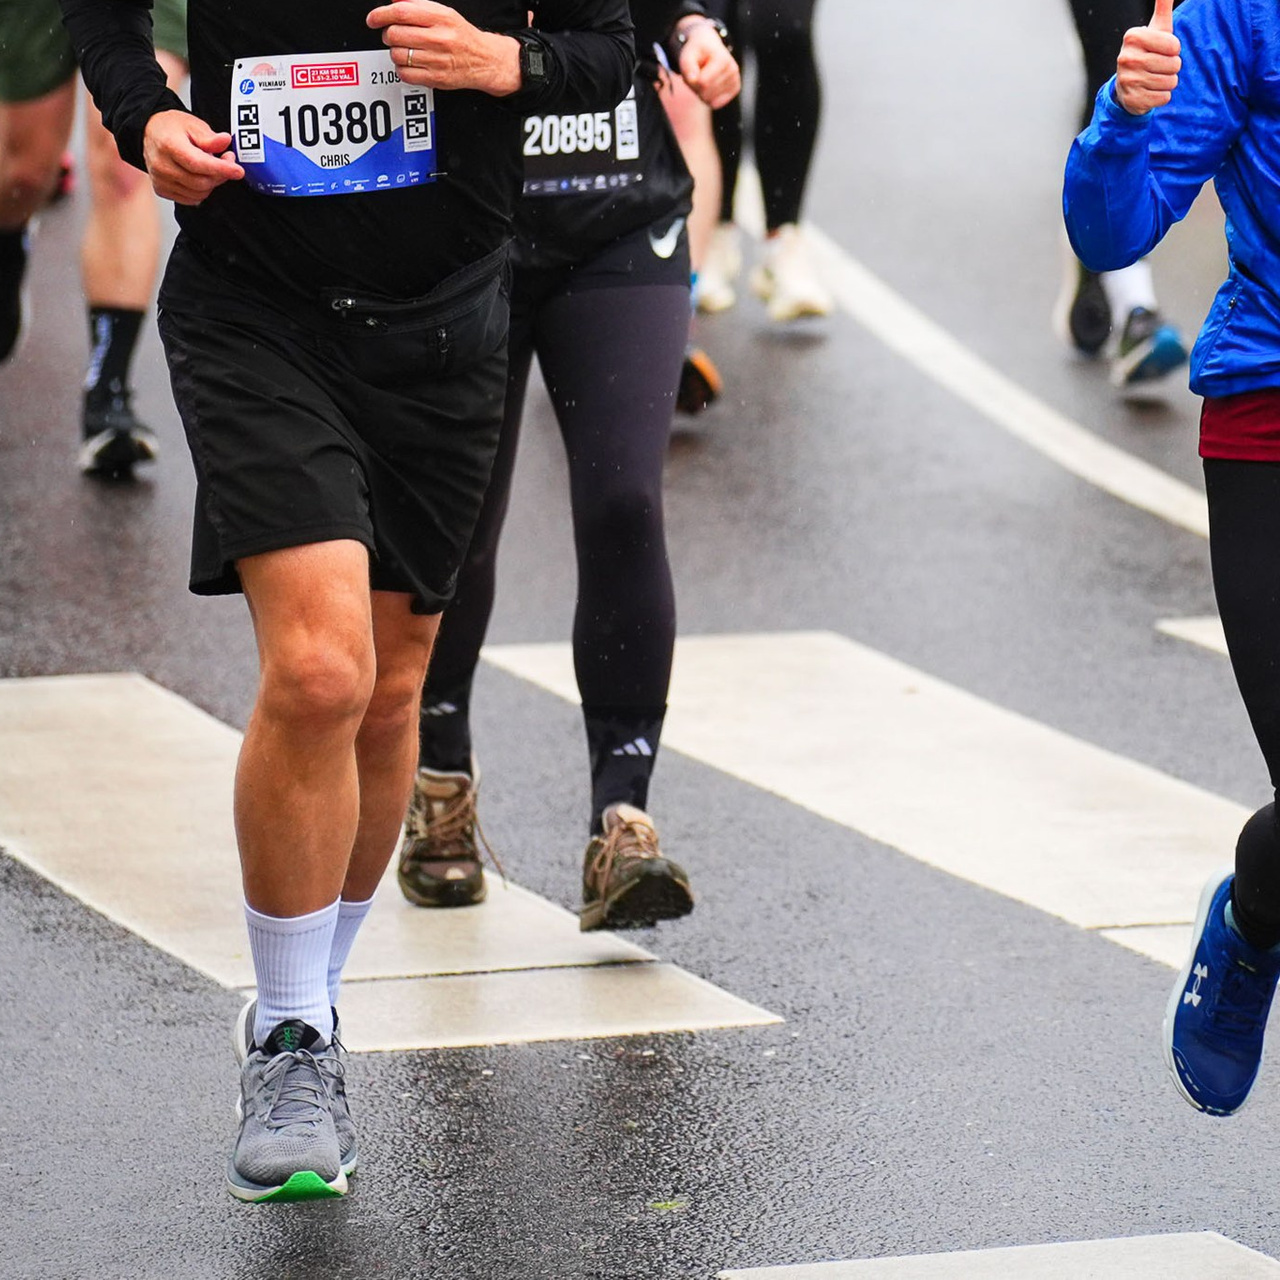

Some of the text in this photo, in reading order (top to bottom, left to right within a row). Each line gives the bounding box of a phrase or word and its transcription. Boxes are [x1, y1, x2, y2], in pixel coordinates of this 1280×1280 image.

[296, 70, 308, 82] C
[258, 80, 287, 88] VILNIAUS
[278, 99, 393, 148] 10380
[522, 111, 612, 156] 20895
[320, 153, 351, 168] CHRIS
